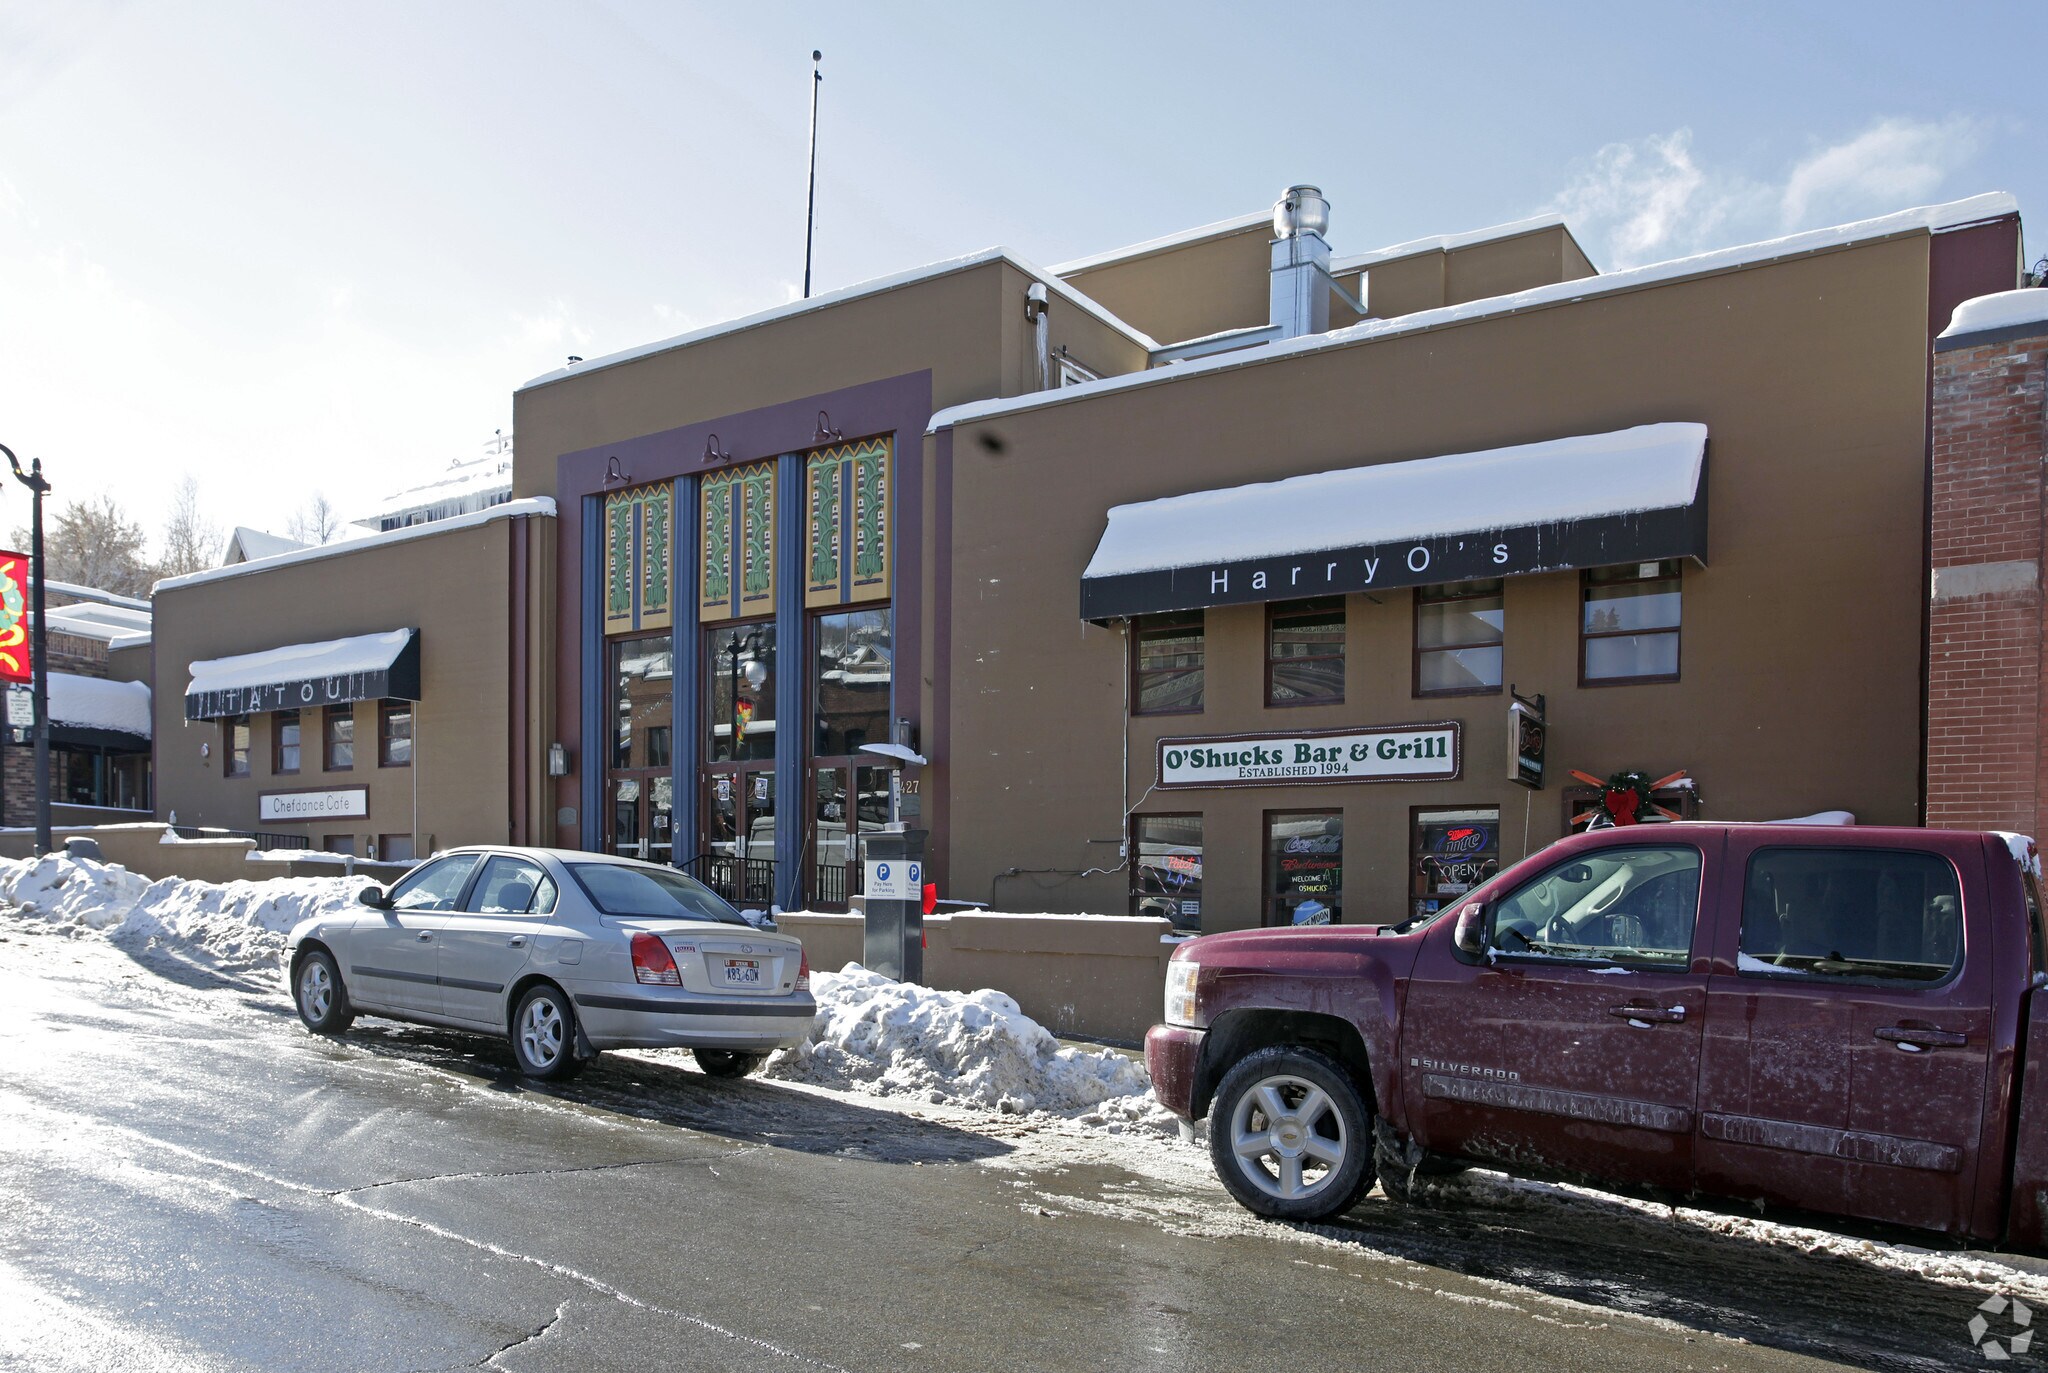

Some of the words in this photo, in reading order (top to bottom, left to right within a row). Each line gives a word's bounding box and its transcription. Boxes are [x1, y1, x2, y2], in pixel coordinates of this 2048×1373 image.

[226, 680, 341, 710] TATOU
[1165, 745, 1283, 769] O'Shucks
[1293, 744, 1342, 764] Bar
[1350, 744, 1368, 762] &
[1376, 737, 1448, 760] Grill
[1239, 766, 1317, 778] ESTABLISHED
[1321, 763, 1349, 775] 1994
[274, 798, 324, 812] Chefdance
[327, 795, 349, 810] Cafe
[1444, 864, 1476, 877] OPEN
[1292, 875, 1321, 883] WELCOME
[727, 968, 740, 981] A83
[1423, 1060, 1519, 1080] SILVERADO
